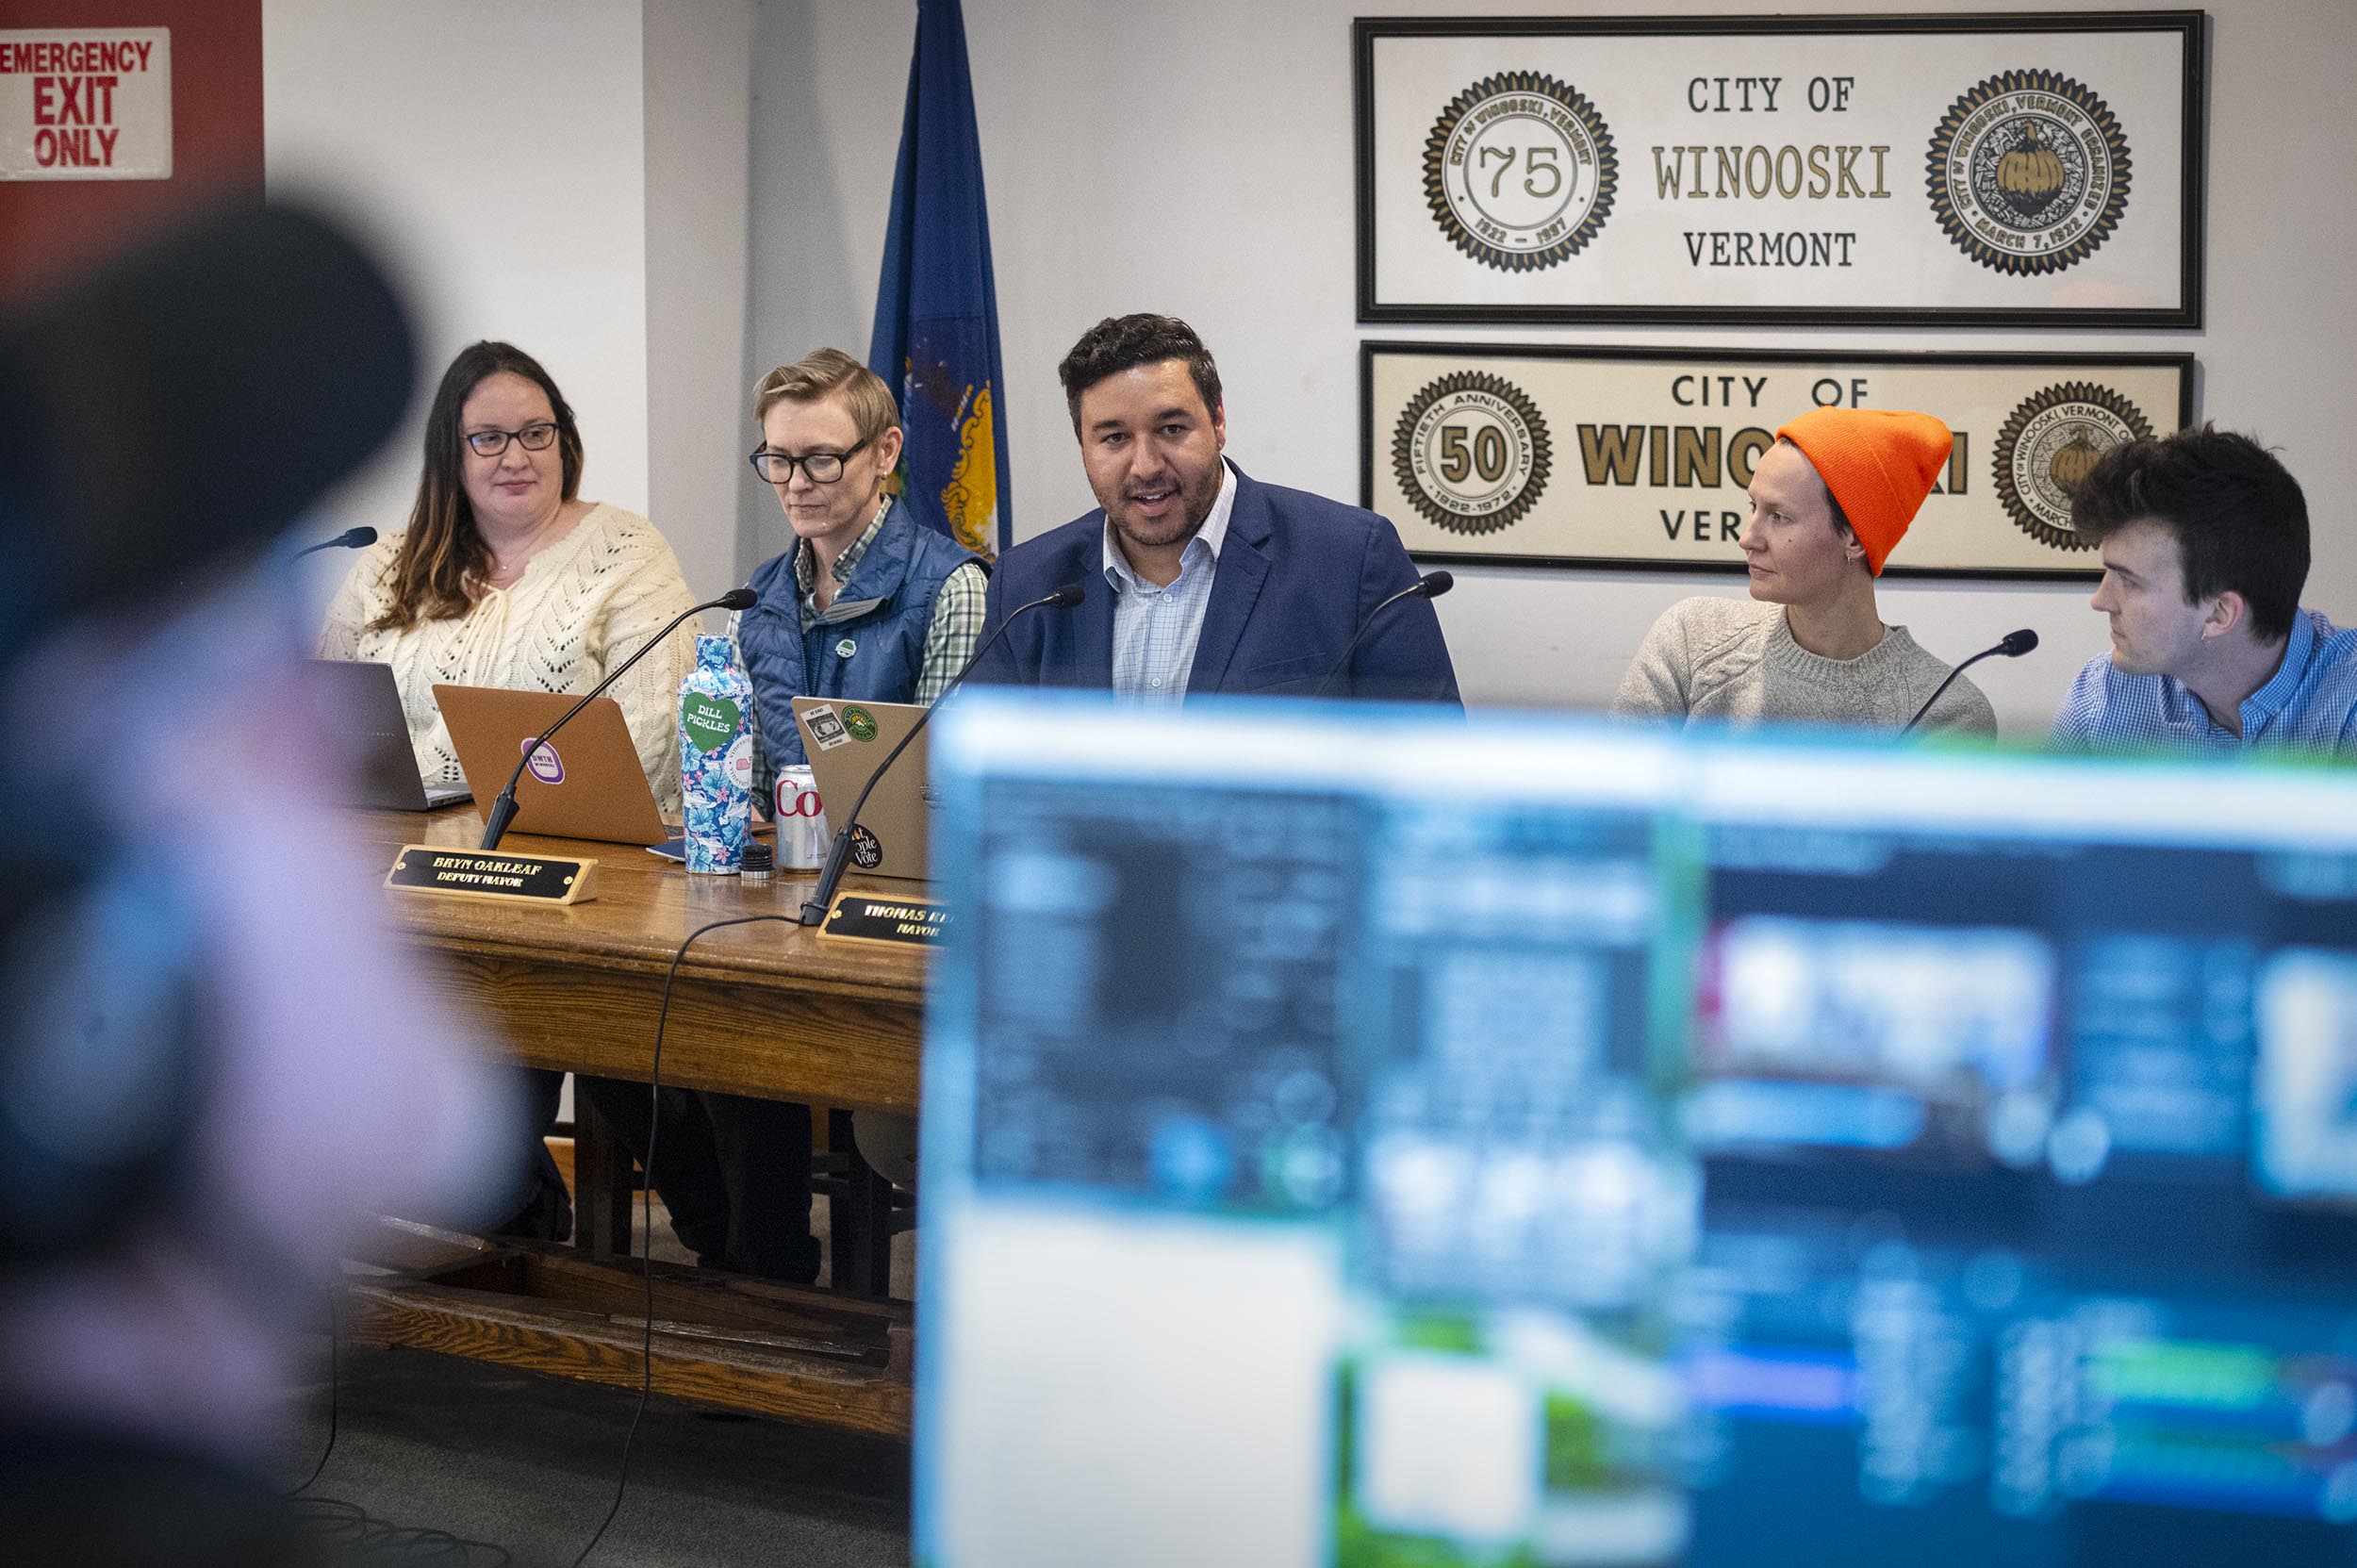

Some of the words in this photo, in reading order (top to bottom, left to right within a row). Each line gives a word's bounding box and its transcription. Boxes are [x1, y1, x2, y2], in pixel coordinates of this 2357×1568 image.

[0, 41, 153, 74] EMERGENCY
[34, 75, 118, 125] EXIT
[1688, 77, 1783, 113] CITY
[1808, 76, 1855, 113] OF
[34, 128, 119, 168] ONLY
[1450, 134, 1468, 166] CITY
[1550, 107, 1592, 166] VERMONT
[2016, 95, 2085, 126] VERMONT
[2080, 127, 2109, 213] ORGANIZED
[1478, 145, 1562, 198] 75
[1652, 145, 1891, 200] WINOOSKI
[1536, 217, 1567, 244] 1997
[1974, 218, 2026, 249] MARCH
[2050, 217, 2083, 245] 1922
[1684, 232, 1856, 267] VERMONT
[1672, 375, 1768, 407] CITY
[1811, 378, 1869, 409] OF
[1414, 404, 1445, 475] FIFTIETH
[1454, 393, 1530, 477] ANNIVERSARY
[2017, 472, 2031, 496] CITY
[2061, 404, 2120, 430] VERMONT
[1441, 424, 1508, 483] 50
[1576, 423, 1970, 496] WINOI
[2033, 503, 2074, 528] MARCH
[686, 714, 731, 734] PICKLES
[698, 704, 723, 719] DILL
[777, 780, 823, 817] Co
[855, 836, 878, 855] ople
[855, 851, 879, 866] Vote
[433, 857, 473, 870] BRYN
[474, 860, 543, 876] OAKLEAF
[437, 872, 482, 884] DEPUTY
[481, 875, 523, 888] MAYOR
[864, 904, 927, 922] THOMAS
[897, 923, 941, 937] MAYOR
